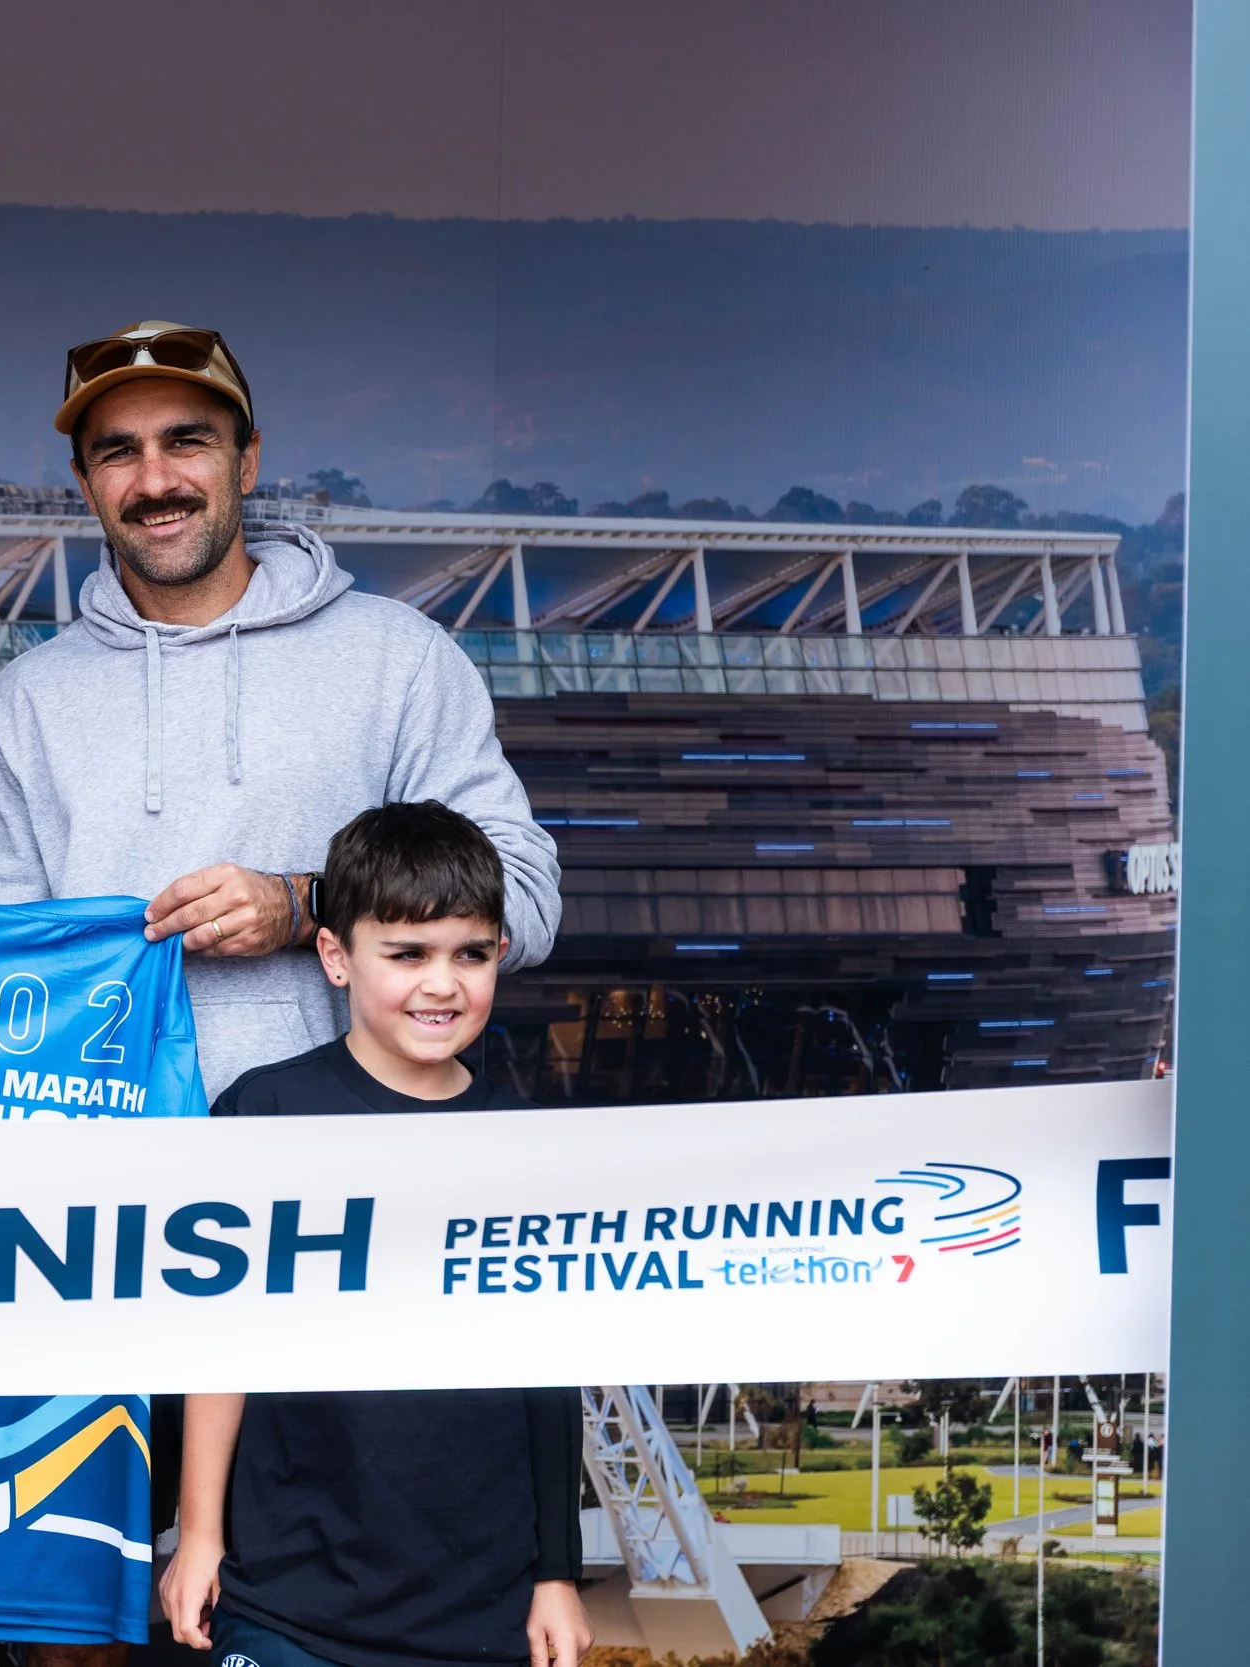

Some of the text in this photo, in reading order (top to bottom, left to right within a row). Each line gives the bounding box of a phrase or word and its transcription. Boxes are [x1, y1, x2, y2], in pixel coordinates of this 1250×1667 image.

[444, 1196, 905, 1250] PERTH RUNNING
[443, 1249, 704, 1295] FESTIVAL
[722, 1255, 873, 1286] telethon
